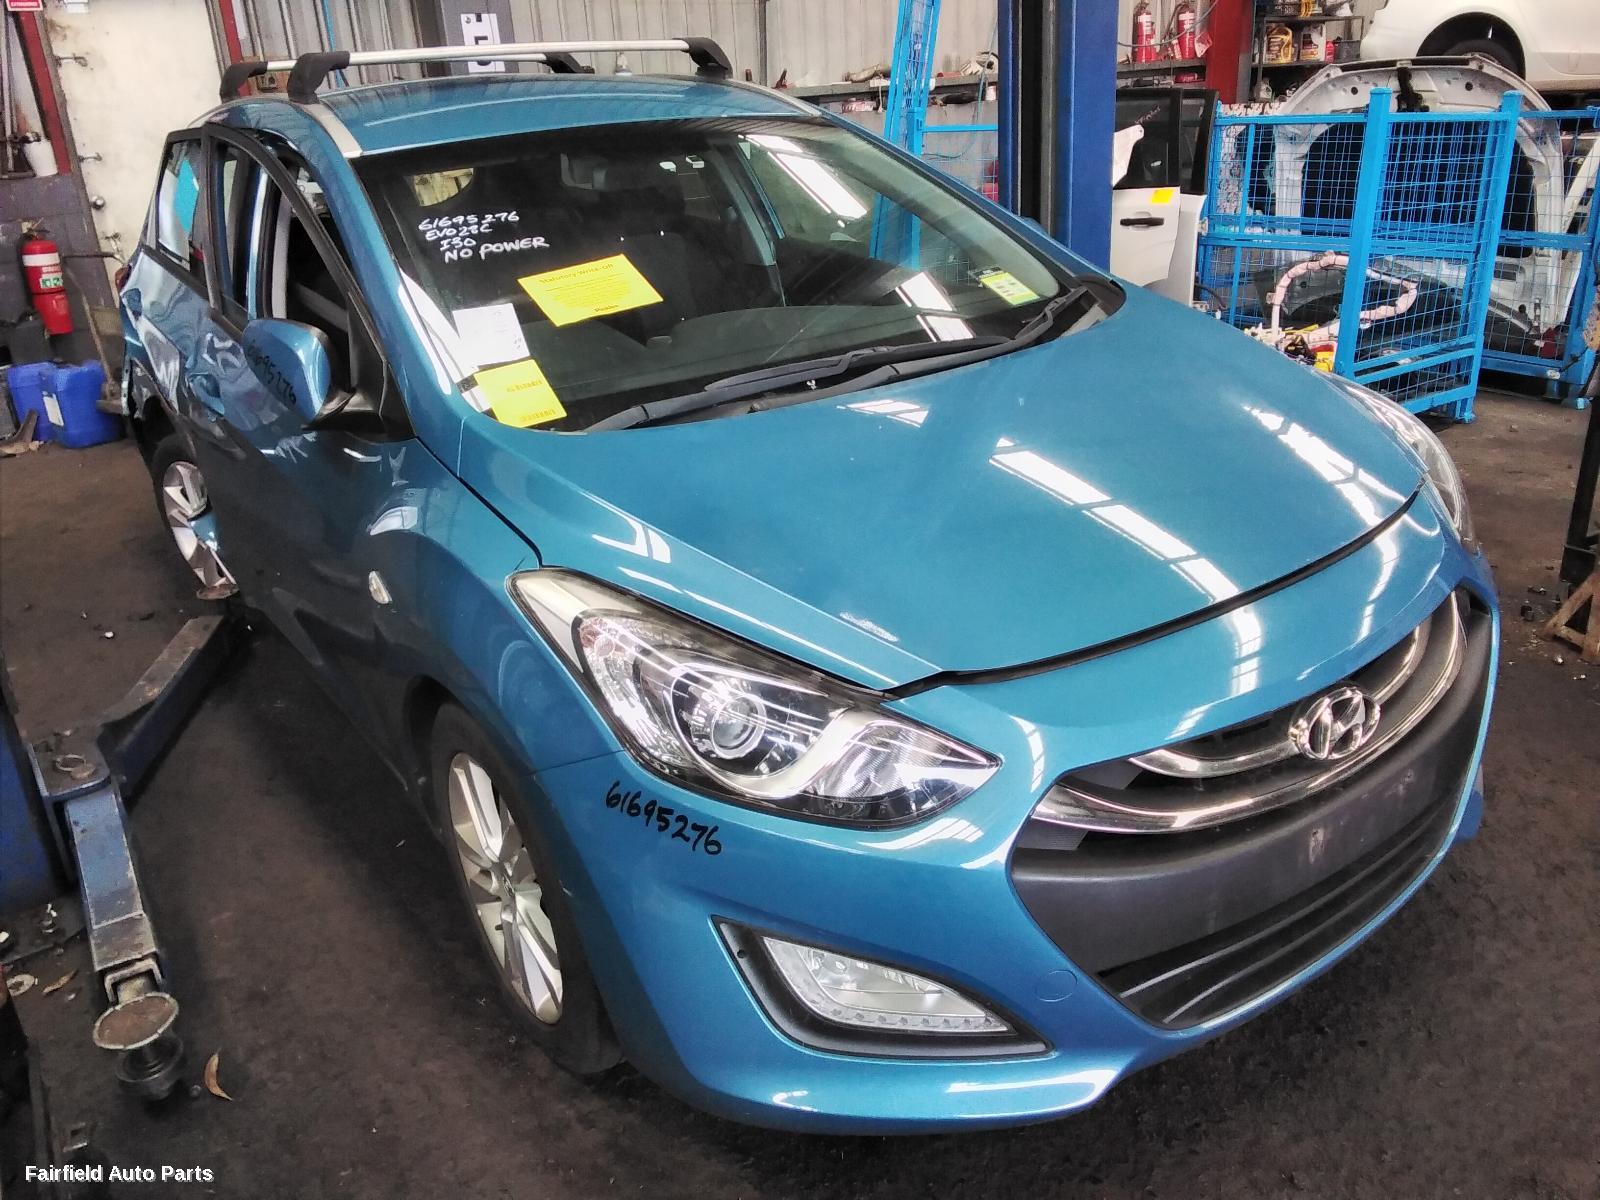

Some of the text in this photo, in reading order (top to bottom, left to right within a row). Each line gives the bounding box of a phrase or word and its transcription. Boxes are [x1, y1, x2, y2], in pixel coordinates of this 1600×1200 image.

[418, 211, 520, 231] 61695276
[444, 236, 550, 264] NO POWER
[605, 780, 722, 855] 61695276
